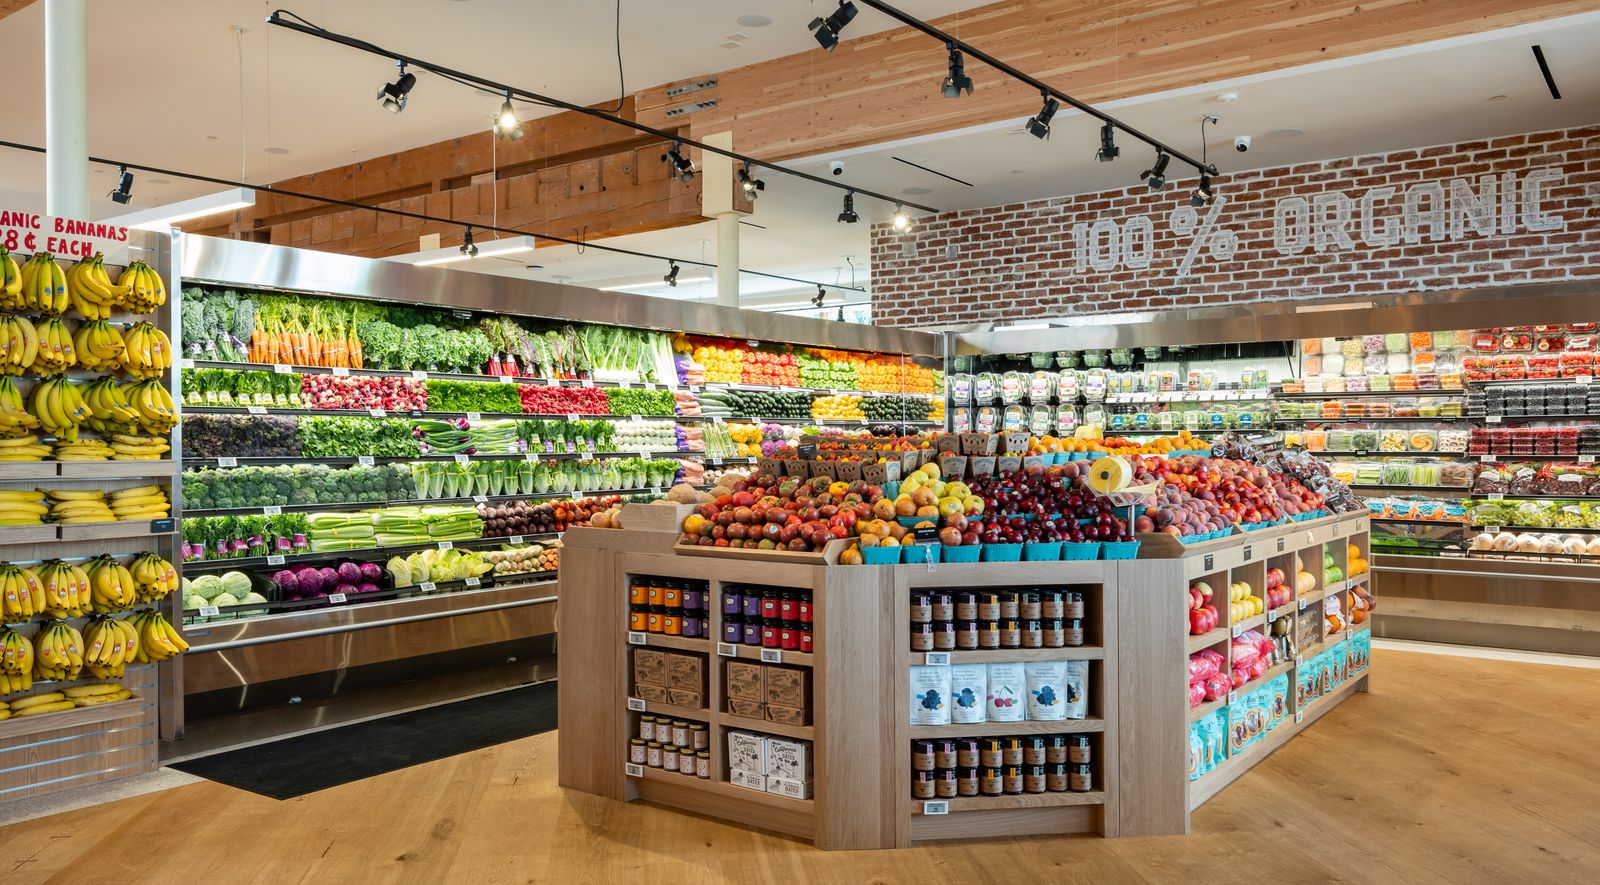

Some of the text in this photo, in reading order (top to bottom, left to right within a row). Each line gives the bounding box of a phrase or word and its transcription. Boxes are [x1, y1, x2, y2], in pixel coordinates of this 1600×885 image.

[1274, 167, 1565, 255] ORGANIC
[55, 217, 129, 241] BANANAS
[47, 236, 92, 257] EACH
